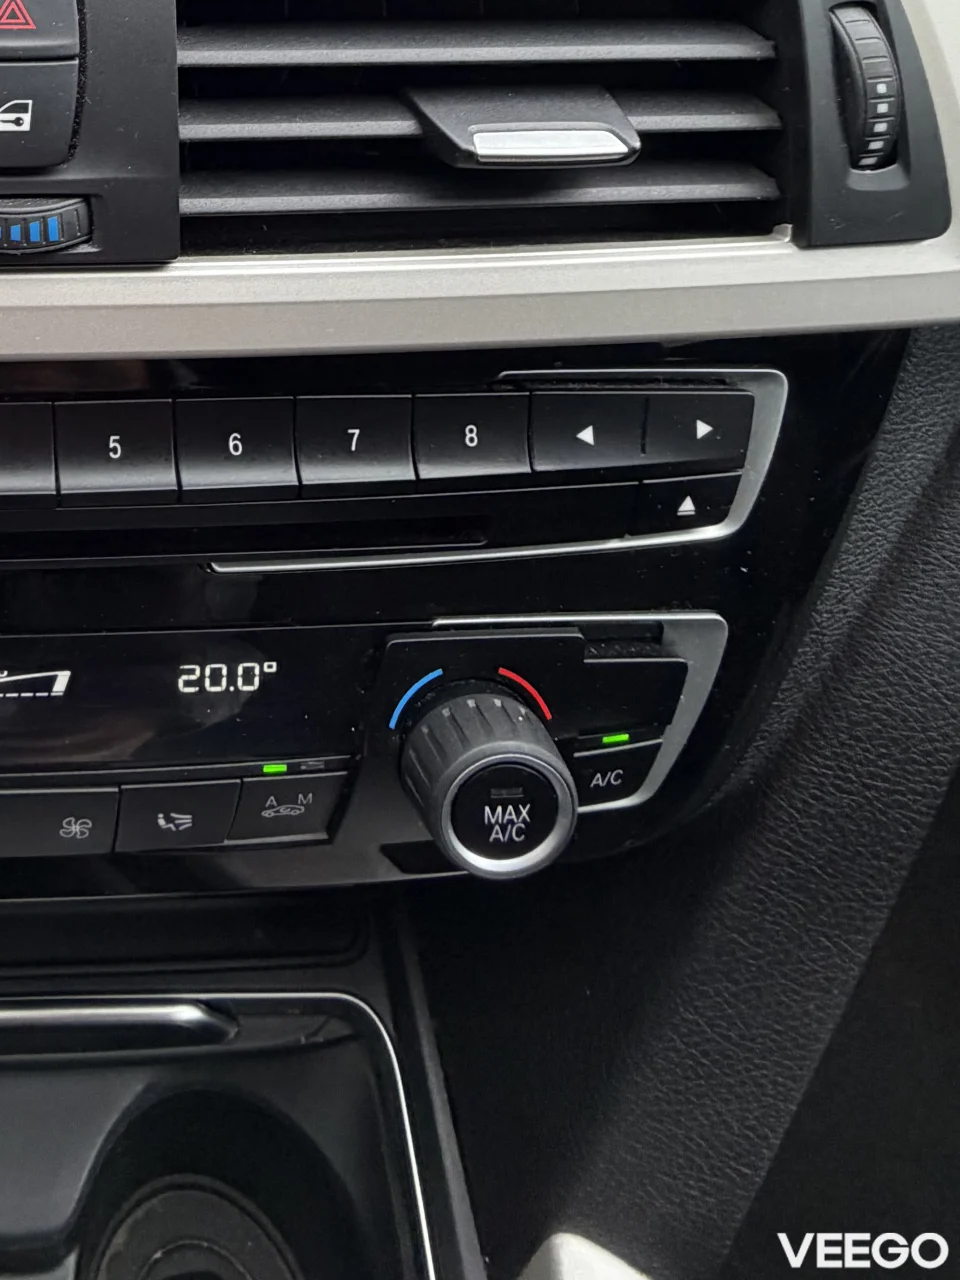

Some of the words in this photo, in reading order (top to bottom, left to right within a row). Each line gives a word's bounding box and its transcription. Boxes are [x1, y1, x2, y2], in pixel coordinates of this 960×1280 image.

[109, 435, 122, 459] 5
[228, 432, 243, 456] 6
[347, 428, 360, 452] 7
[464, 424, 478, 448] 8
[590, 769, 624, 788] A/C
[265, 795, 278, 808] A
[297, 792, 313, 805] M
[484, 803, 531, 825] MAX
[488, 823, 526, 842] A/C
